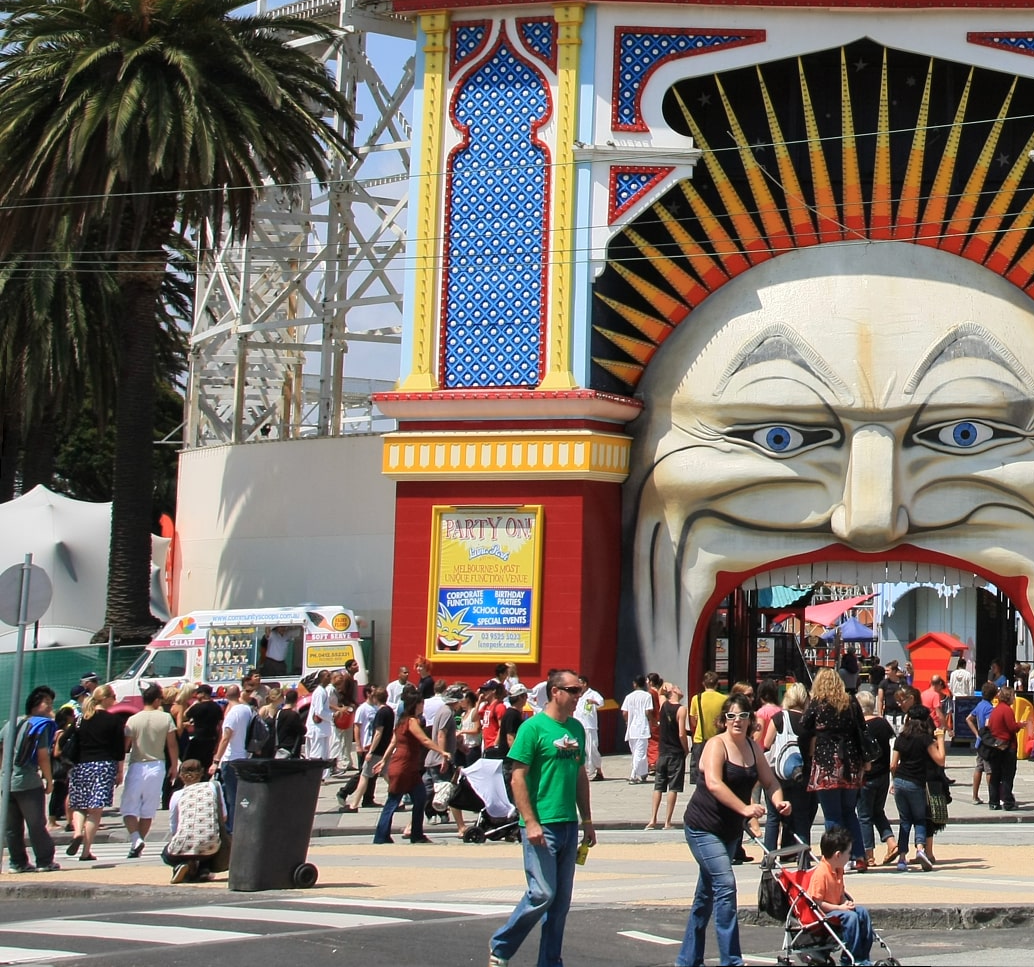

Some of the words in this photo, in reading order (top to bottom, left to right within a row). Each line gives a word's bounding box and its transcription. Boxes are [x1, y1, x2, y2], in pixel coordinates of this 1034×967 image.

[446, 516, 503, 541] PARTY
[505, 517, 533, 540] ON!
[500, 564, 520, 574] MOST
[444, 573, 469, 583] UNIQUE
[470, 574, 504, 583] FUNCTION
[505, 574, 528, 583] VENUE
[446, 590, 483, 599] CORPORATE
[494, 590, 525, 599] BIRTHDAY
[447, 598, 483, 607] FUNCTIONS
[497, 598, 522, 606] PARTIES
[472, 606, 499, 614] SCHOOL
[477, 617, 501, 626] SPECIAL
[502, 616, 527, 624] EVENTS
